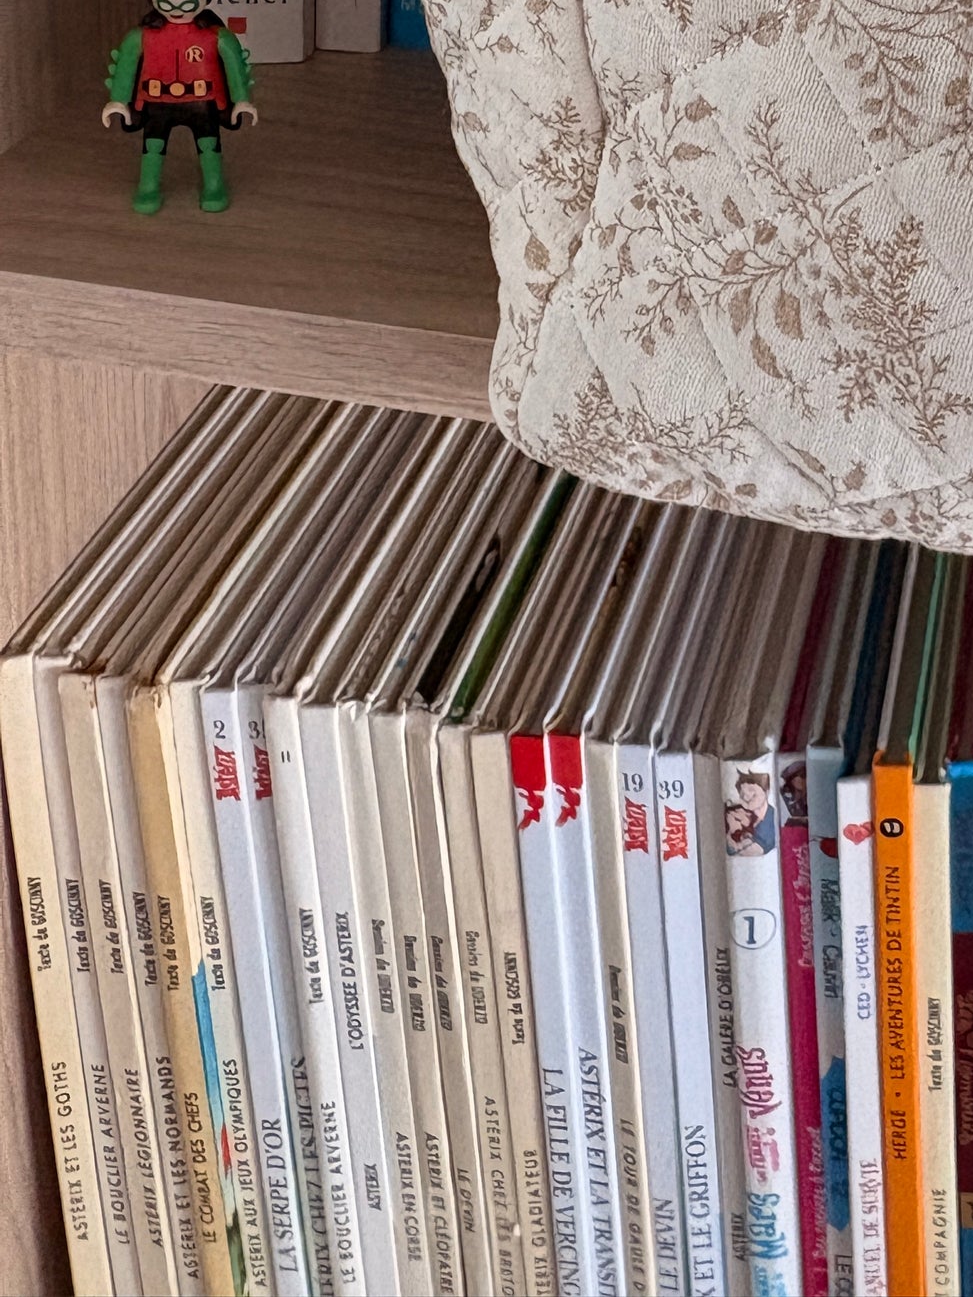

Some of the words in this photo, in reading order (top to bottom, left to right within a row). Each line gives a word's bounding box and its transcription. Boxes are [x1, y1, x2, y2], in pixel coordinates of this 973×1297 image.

[213, 720, 227, 739] 2
[622, 772, 644, 793] 19
[658, 779, 685, 800] 39
[885, 866, 901, 925] TINTIN
[743, 916, 757, 945] 1
[886, 932, 903, 952] DE
[856, 992, 871, 1020] CED
[886, 957, 906, 1052] AVENTURES
[543, 1067, 566, 1101] LA
[890, 1056, 906, 1081] LES
[51, 1060, 73, 1117] GOTHS
[90, 1063, 116, 1138] ARVERNE
[155, 1056, 185, 1153] NORMANDS
[579, 1046, 606, 1142] ASTÉRIX
[184, 1092, 204, 1133] CHEFS
[222, 1058, 249, 1154] OLYMPIQUES
[261, 1117, 288, 1171] D'OR
[321, 1100, 344, 1175] ARVERNE
[546, 1104, 570, 1164] FILLE
[192, 1138, 208, 1164] DES
[585, 1145, 609, 1172] ET
[623, 1146, 638, 1183] TOUR
[102, 1144, 126, 1223] BOUCLIER
[170, 1158, 187, 1187] LES
[236, 1158, 253, 1191] JEUX
[552, 1169, 574, 1199] DE
[685, 1124, 712, 1218] GRIFFON
[175, 1193, 191, 1210] ET
[192, 1168, 216, 1225] COMBAT
[589, 1178, 610, 1206] LA
[859, 1158, 880, 1218] SURVIE
[241, 1197, 259, 1228] AUX
[267, 1176, 295, 1242] SERPE
[330, 1182, 354, 1262] BOUCLIER
[114, 1229, 131, 1245] LE
[200, 1229, 217, 1243] LE
[652, 1197, 679, 1263] DEVIN
[692, 1223, 714, 1249] LE
[862, 1219, 880, 1239] DE
[931, 1189, 950, 1286] COMPAGNIE
[279, 1246, 299, 1274] LA
[694, 1256, 716, 1281] ET
[659, 1267, 680, 1292] LE
